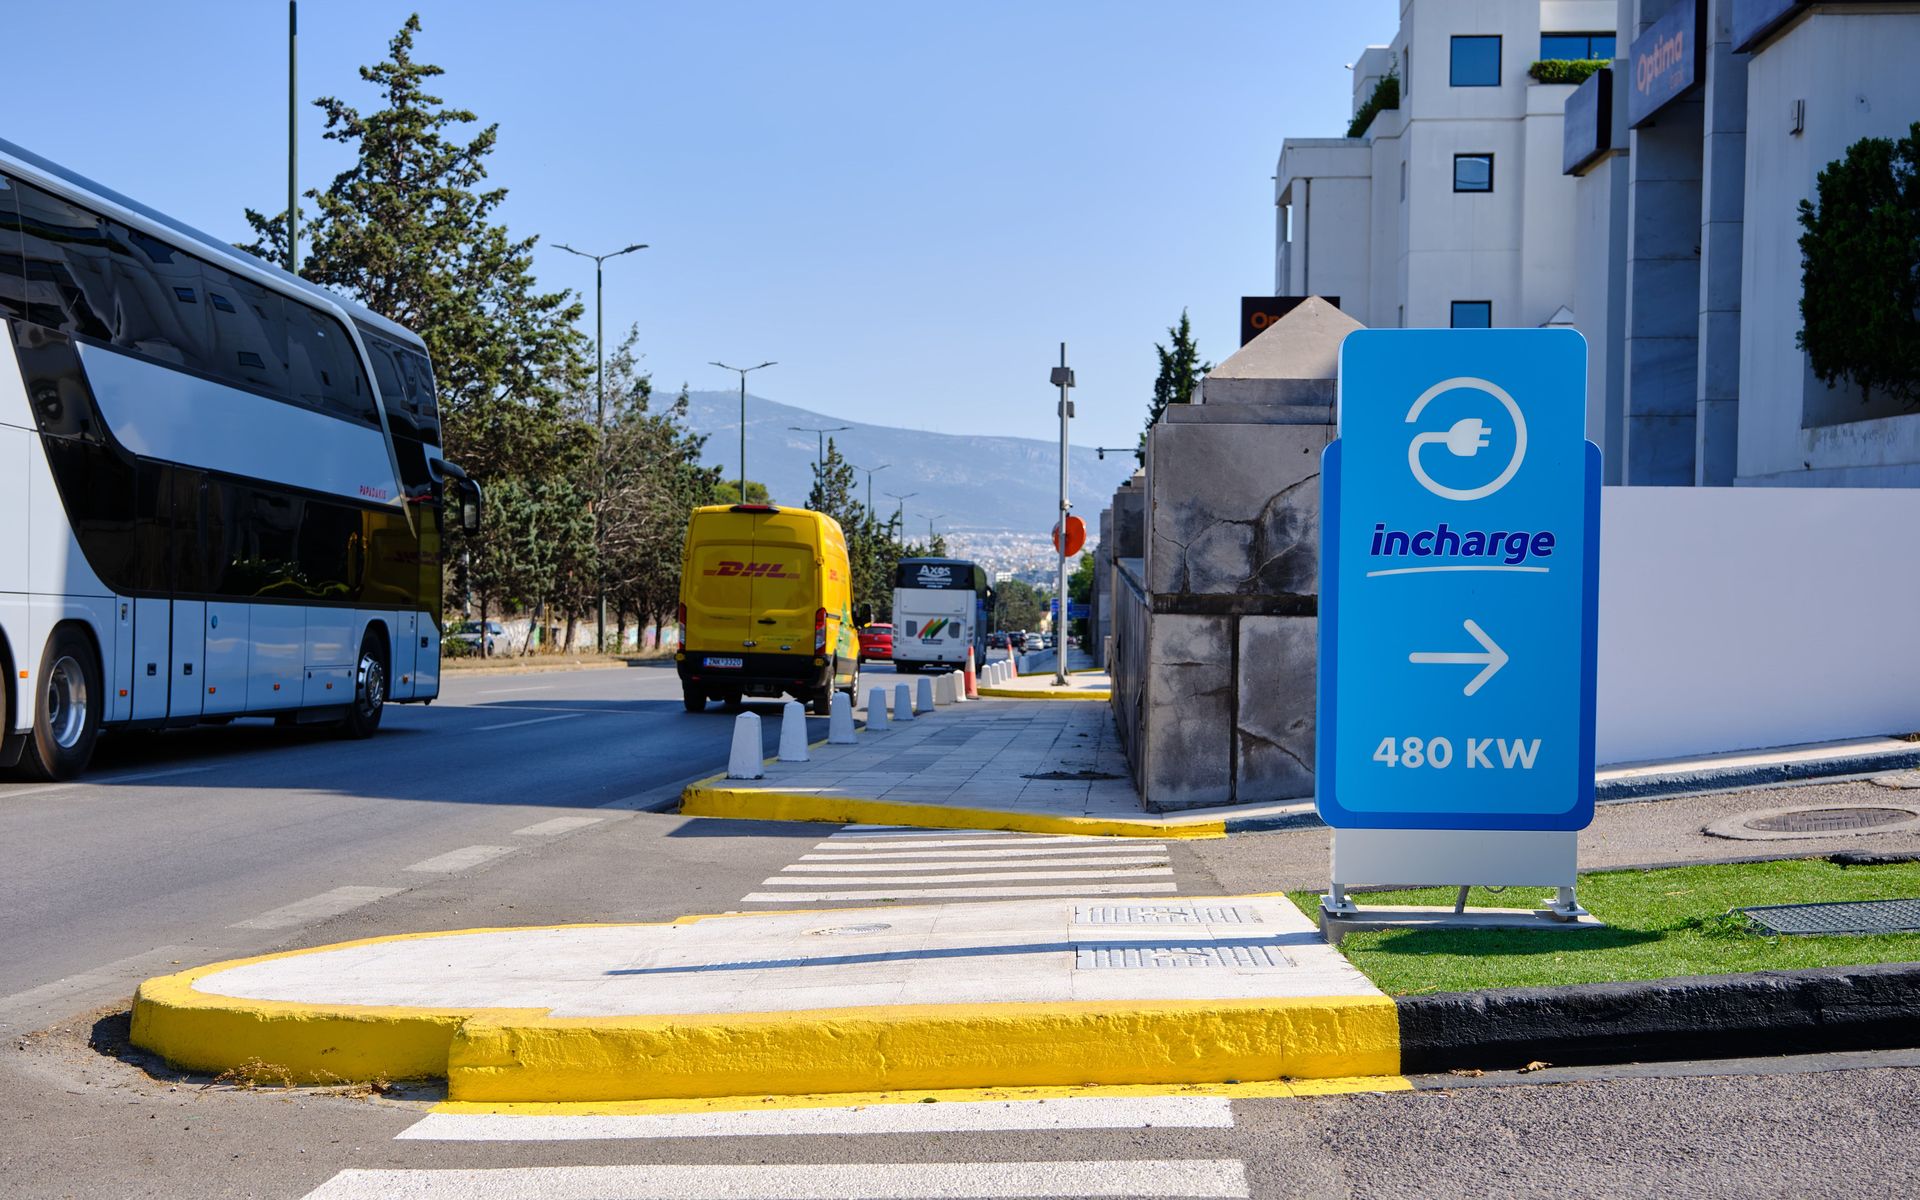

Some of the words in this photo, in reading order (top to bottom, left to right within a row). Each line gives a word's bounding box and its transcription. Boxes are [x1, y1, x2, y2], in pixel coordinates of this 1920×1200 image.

[1637, 31, 1683, 96] Optima
[1370, 522, 1556, 565] incharge
[717, 561, 787, 578] DHL
[1372, 736, 1453, 769] 480
[1466, 737, 1542, 769] KW
